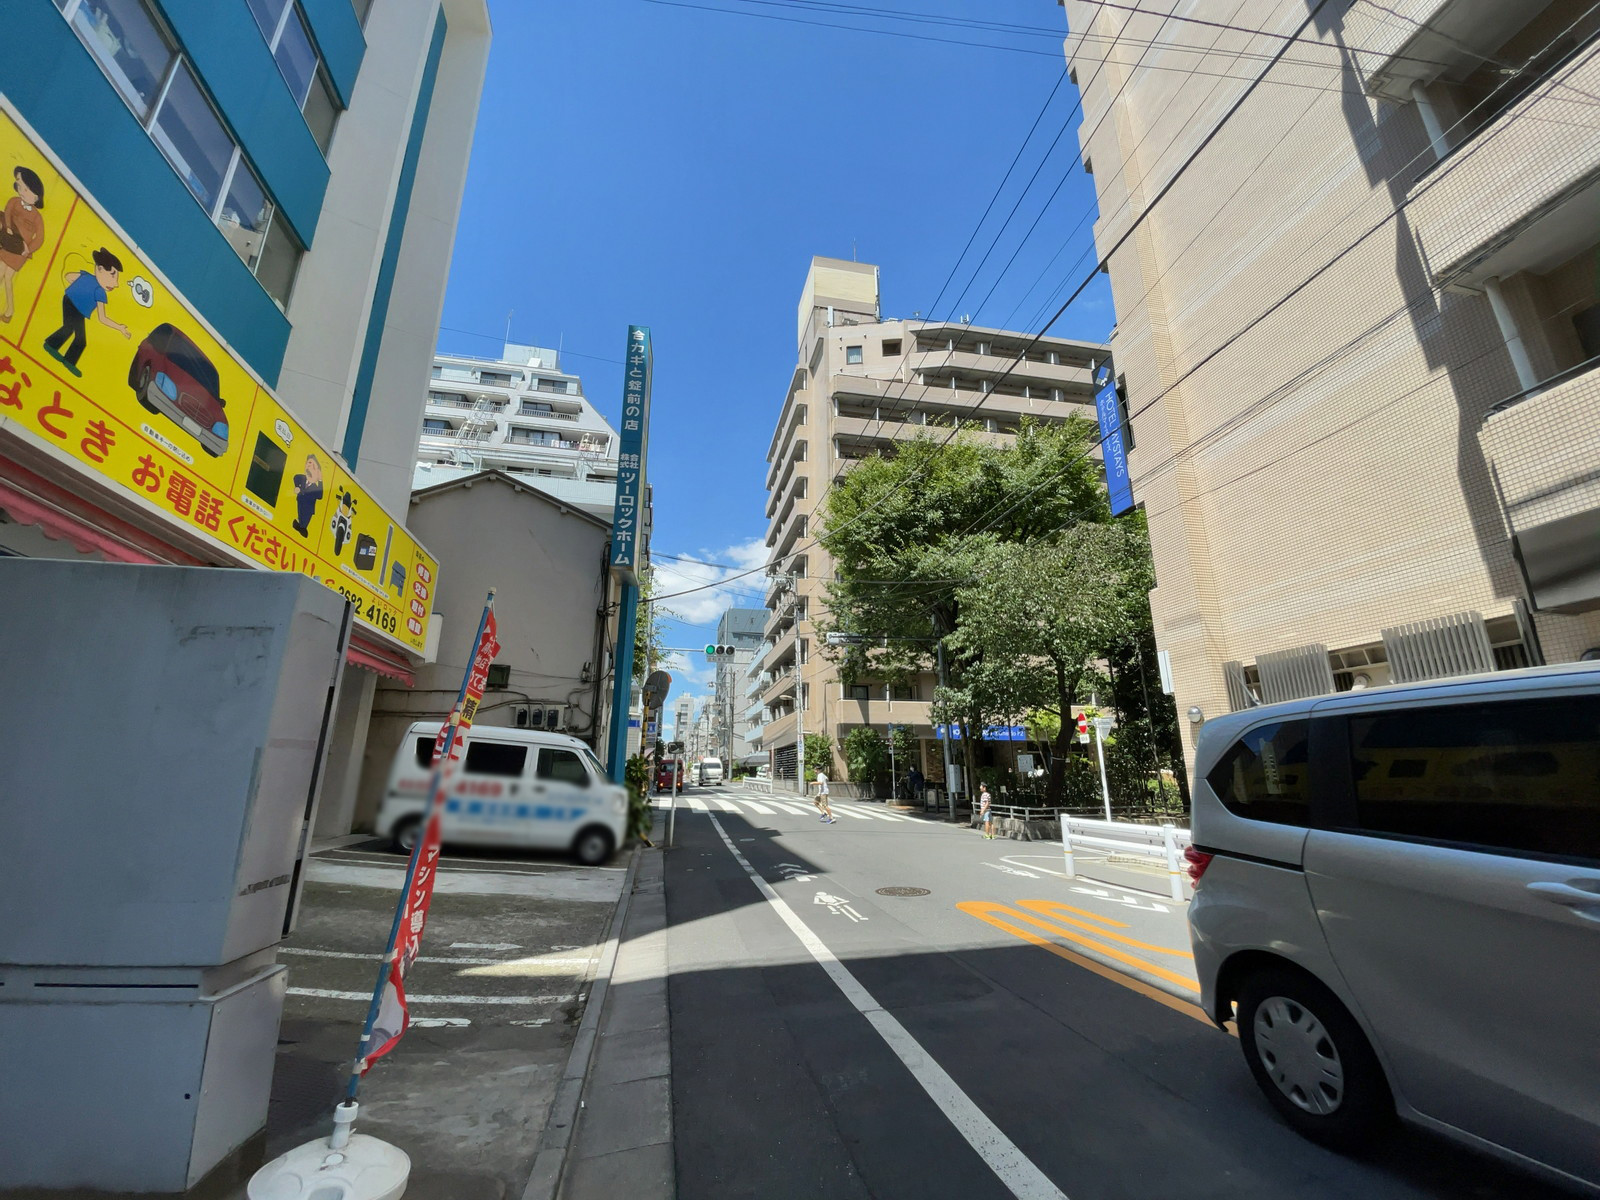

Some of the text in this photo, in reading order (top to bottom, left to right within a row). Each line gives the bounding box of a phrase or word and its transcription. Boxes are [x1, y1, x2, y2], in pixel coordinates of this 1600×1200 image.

[624, 329, 646, 431] 合カギと錠前の店
[1105, 391, 1117, 428] HOTEL
[614, 472, 636, 565] ツーロックホーム
